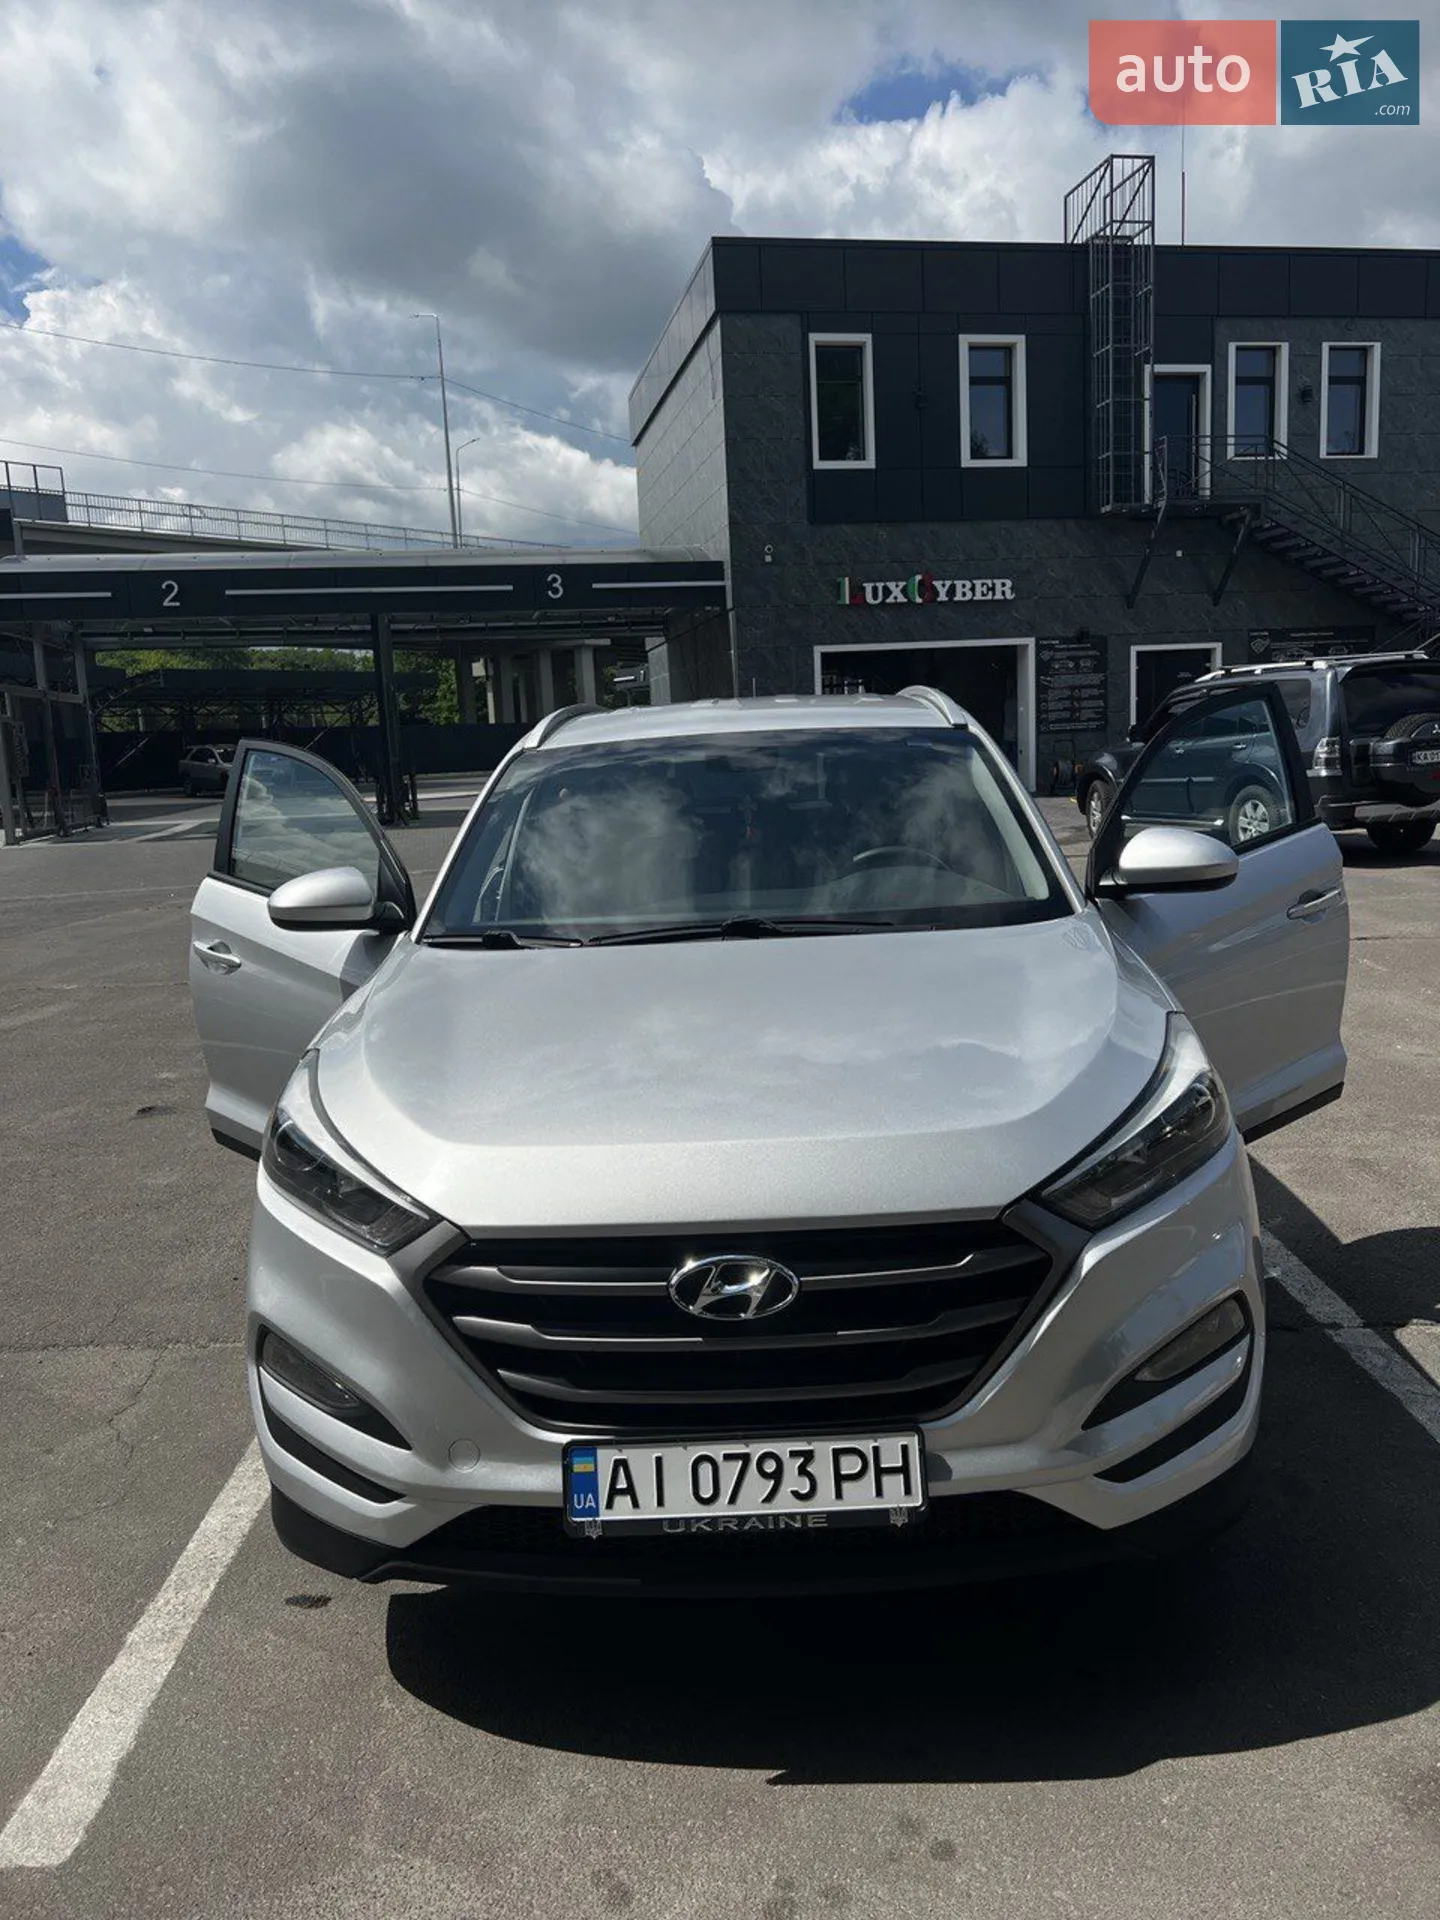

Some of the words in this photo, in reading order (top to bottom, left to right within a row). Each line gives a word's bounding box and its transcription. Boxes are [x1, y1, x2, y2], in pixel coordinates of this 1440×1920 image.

[161, 580, 180, 606] 2
[547, 573, 563, 599] 3
[574, 1492, 597, 1510] UA
[662, 1513, 829, 1534] UKRAINE
